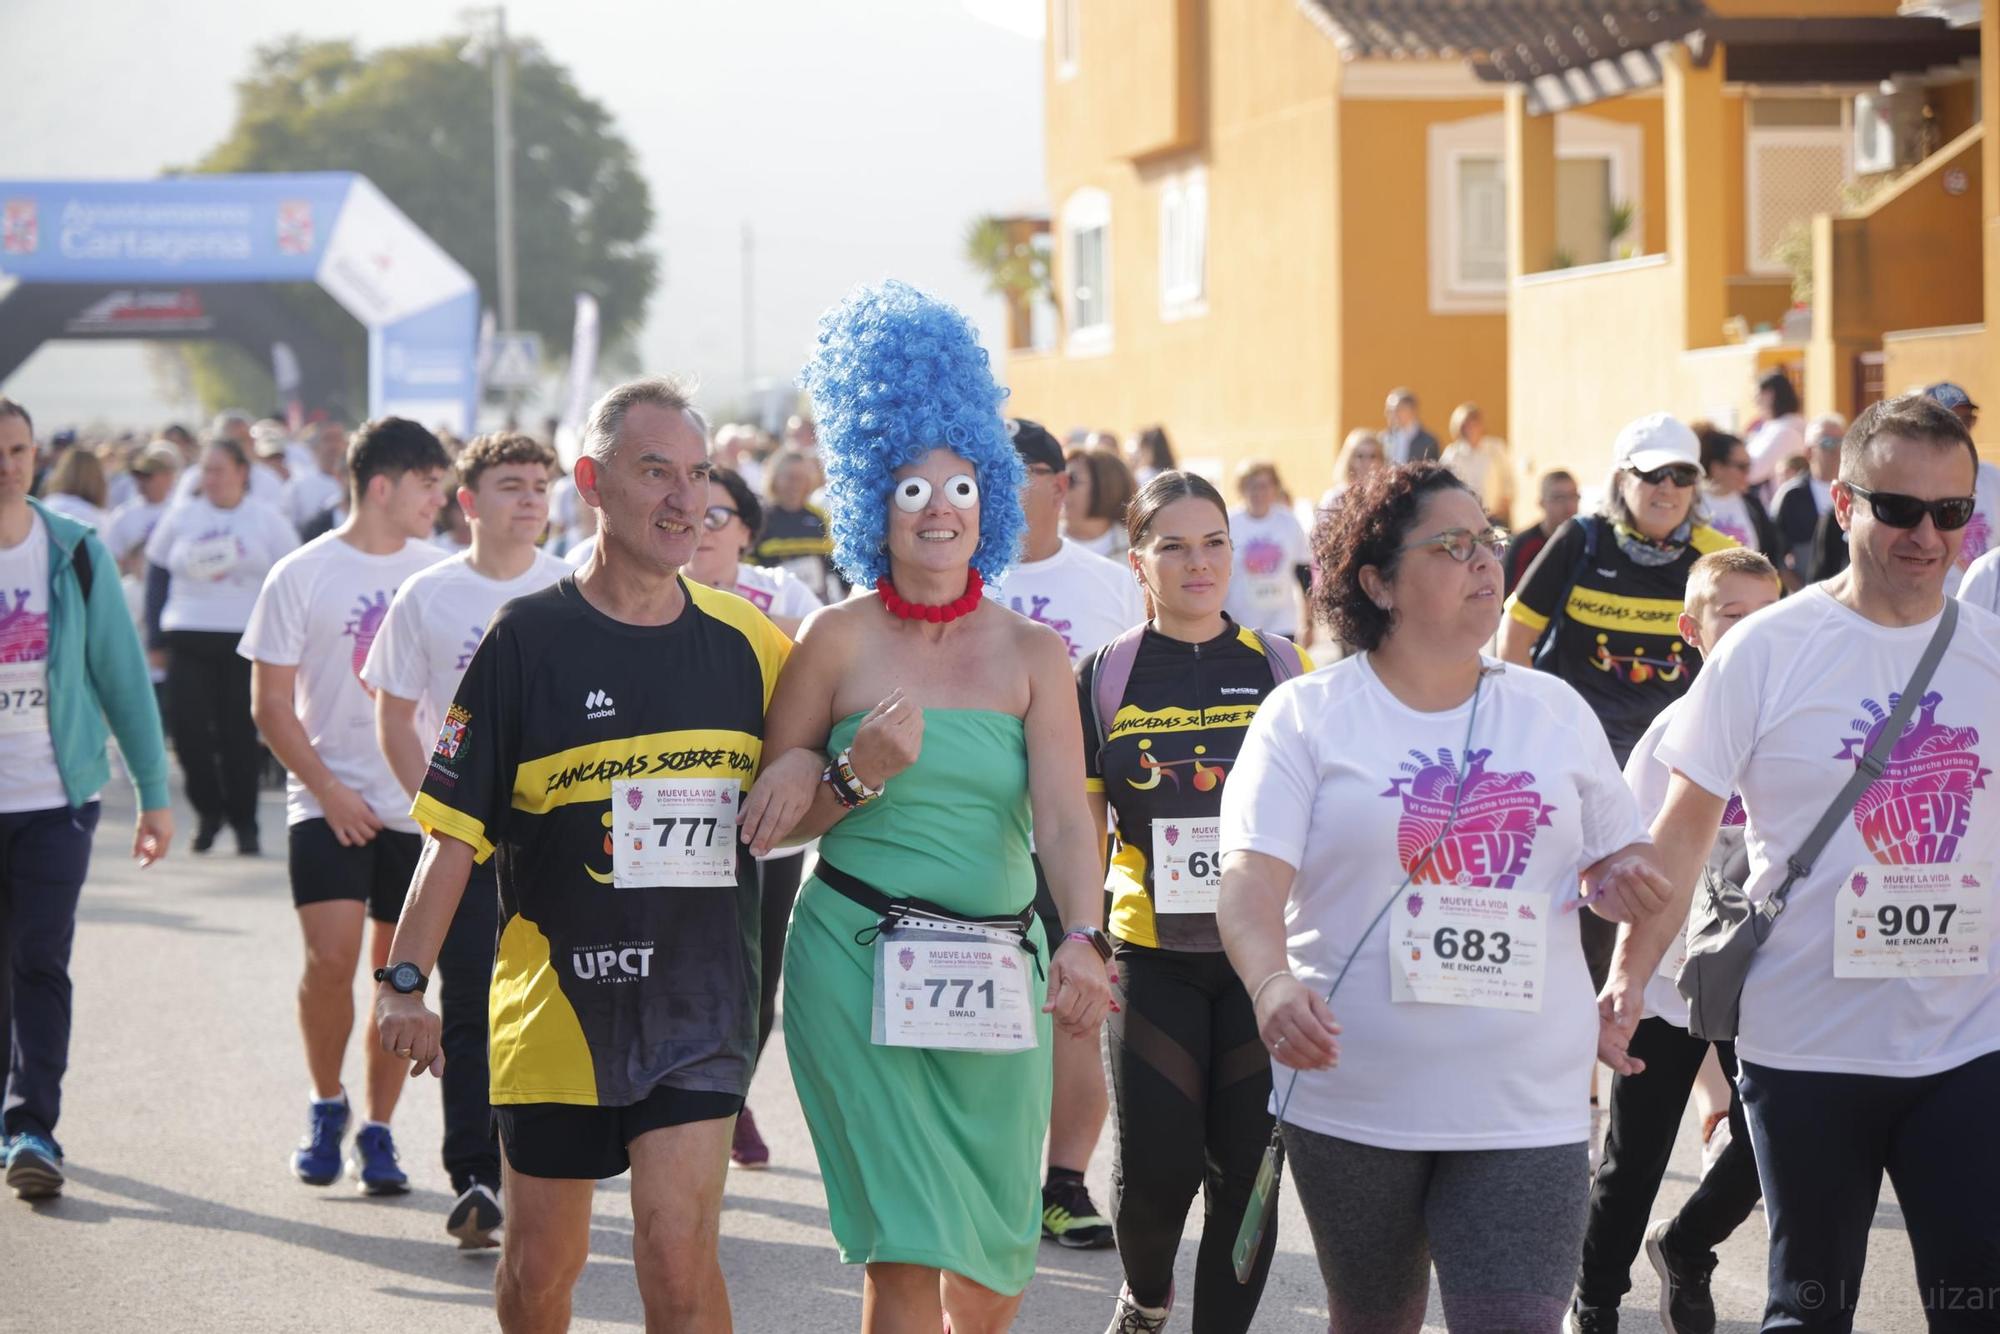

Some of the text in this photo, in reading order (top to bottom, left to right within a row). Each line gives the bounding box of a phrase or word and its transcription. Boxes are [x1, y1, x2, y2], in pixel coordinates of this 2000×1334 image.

[60, 228, 252, 264] Cartagena
[587, 708, 616, 720] mobel
[545, 753, 648, 794] ZANCADAS
[648, 748, 727, 774] SOBRE
[1910, 760, 1941, 773] Marcha
[1943, 757, 1973, 767] Urbana
[658, 789, 716, 798] MUEVE LA VIDA
[1460, 802, 1497, 815] Marcha
[1498, 795, 1535, 805] Urbana
[1192, 826, 1220, 834] MUEVE
[1862, 793, 1970, 851] MUEVE
[652, 817, 717, 847] 777
[685, 849, 696, 857] PU
[1407, 832, 1532, 885] MUEVE
[1884, 874, 1950, 884] MUEVE LA VIDA
[1440, 896, 1508, 910] MUEVE LA VIDA
[1878, 904, 1957, 936] 907
[1433, 927, 1511, 964] 683
[1885, 937, 1949, 946] ME ENCANTA
[573, 947, 654, 980] UPCT
[929, 951, 959, 959] MUEVE
[973, 952, 992, 960] VIDA
[1441, 962, 1503, 975] ME ENCANTA
[924, 979, 995, 1009] 771
[949, 1010, 976, 1018] BWAD
